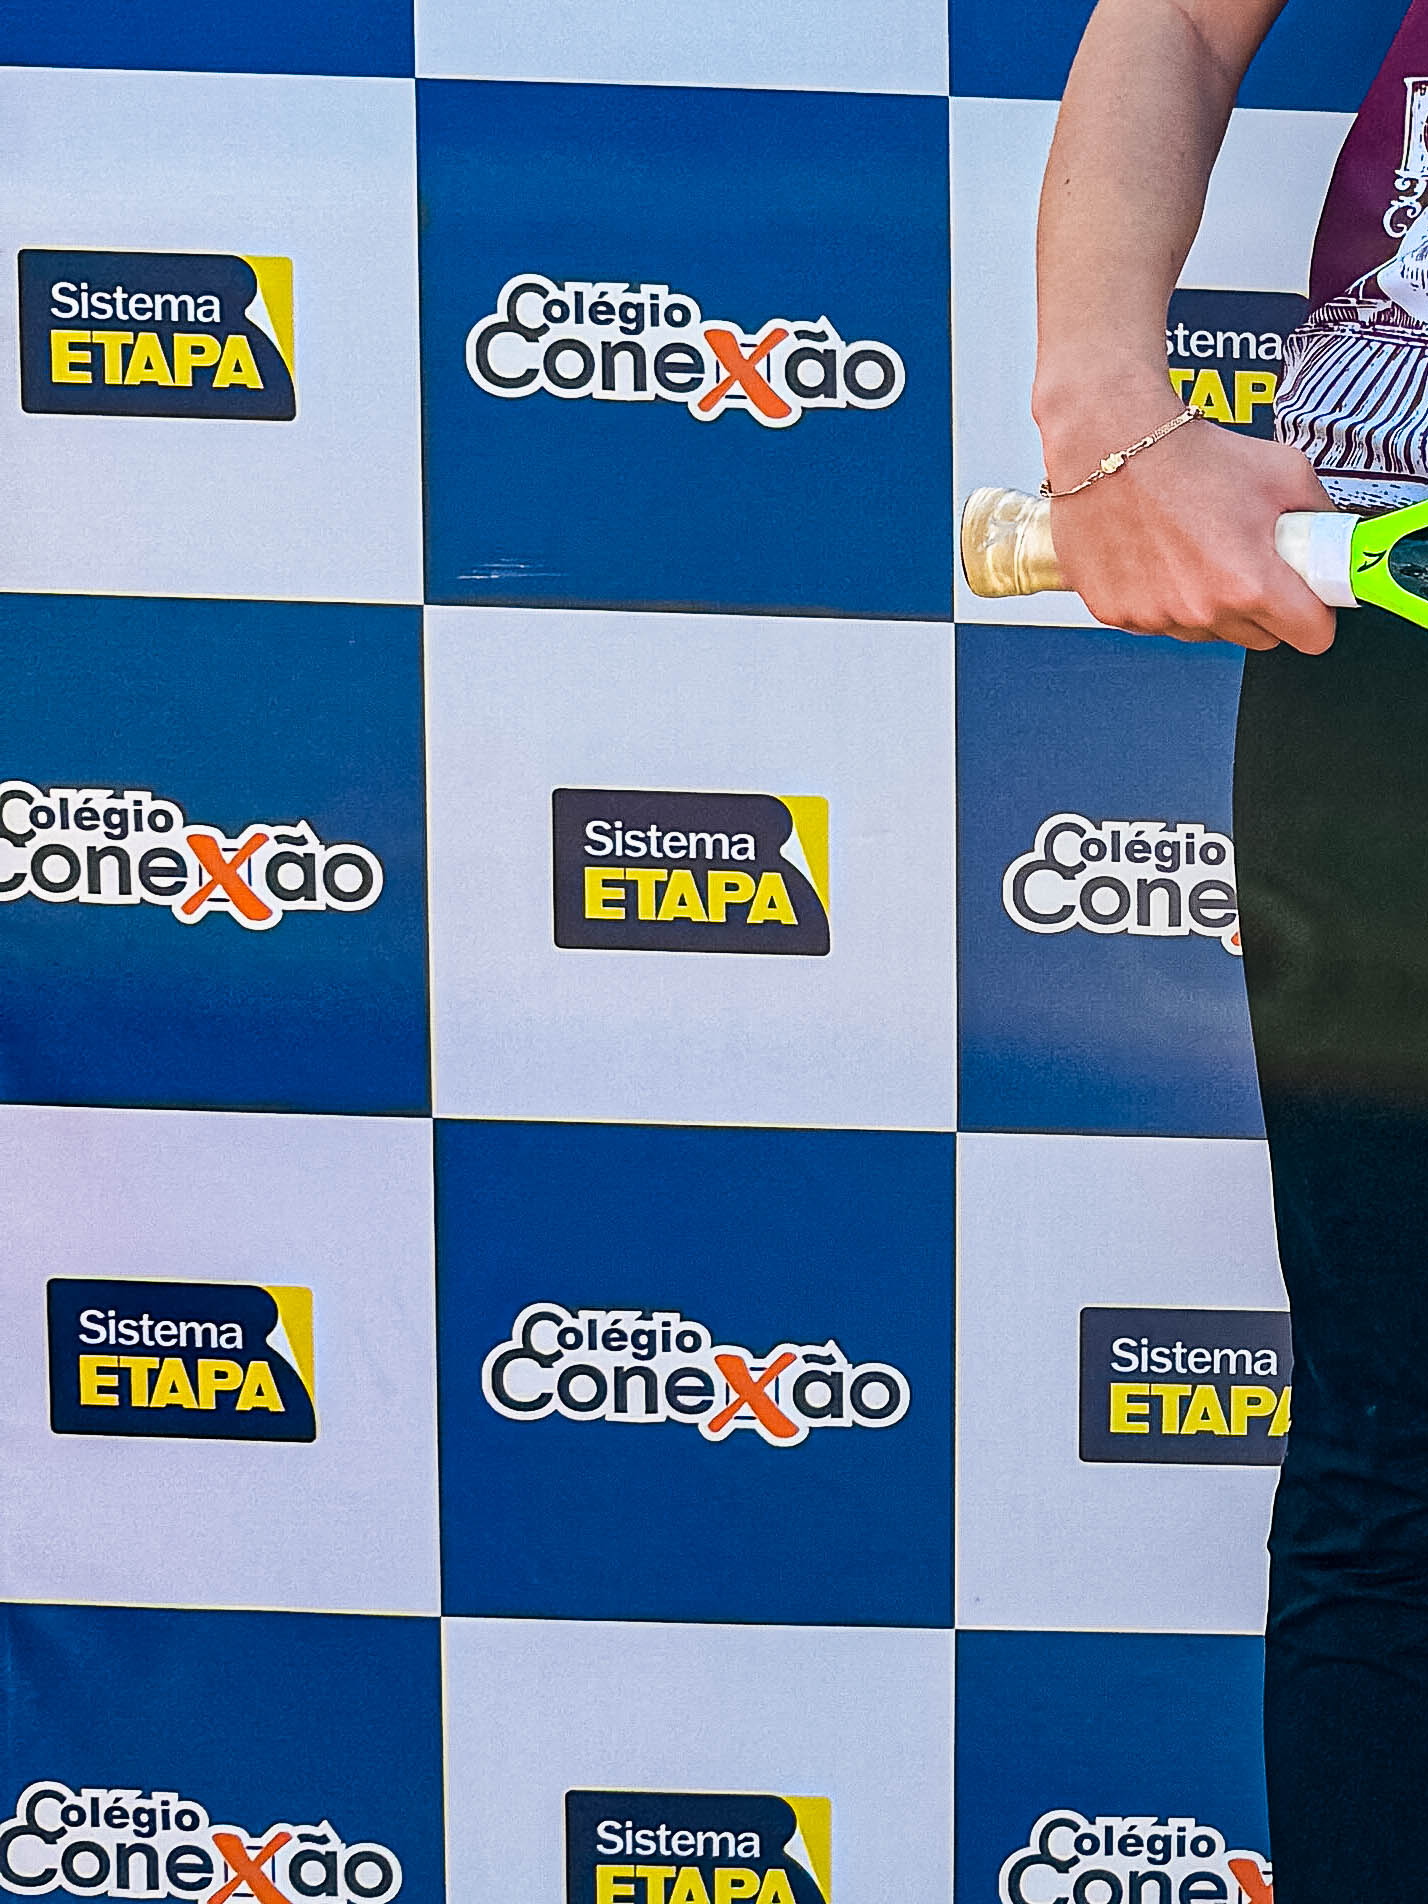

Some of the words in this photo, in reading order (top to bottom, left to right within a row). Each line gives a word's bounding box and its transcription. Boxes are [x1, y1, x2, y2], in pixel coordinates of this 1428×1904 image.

[50, 281, 221, 323] Sistema
[506, 282, 692, 336] Colégio
[50, 329, 264, 389] ETAPA
[584, 820, 755, 860] Sistema
[1044, 822, 1227, 873] Colégio
[584, 866, 798, 925] ETAPA
[79, 1309, 243, 1349] Sistema
[521, 1311, 703, 1361] Colégio
[1110, 1337, 1278, 1375] Sistema
[79, 1354, 285, 1412] ETAPA
[25, 1789, 201, 1839] Colégio
[596, 1820, 760, 1858] Sistema
[1039, 1818, 1217, 1866] Colégio
